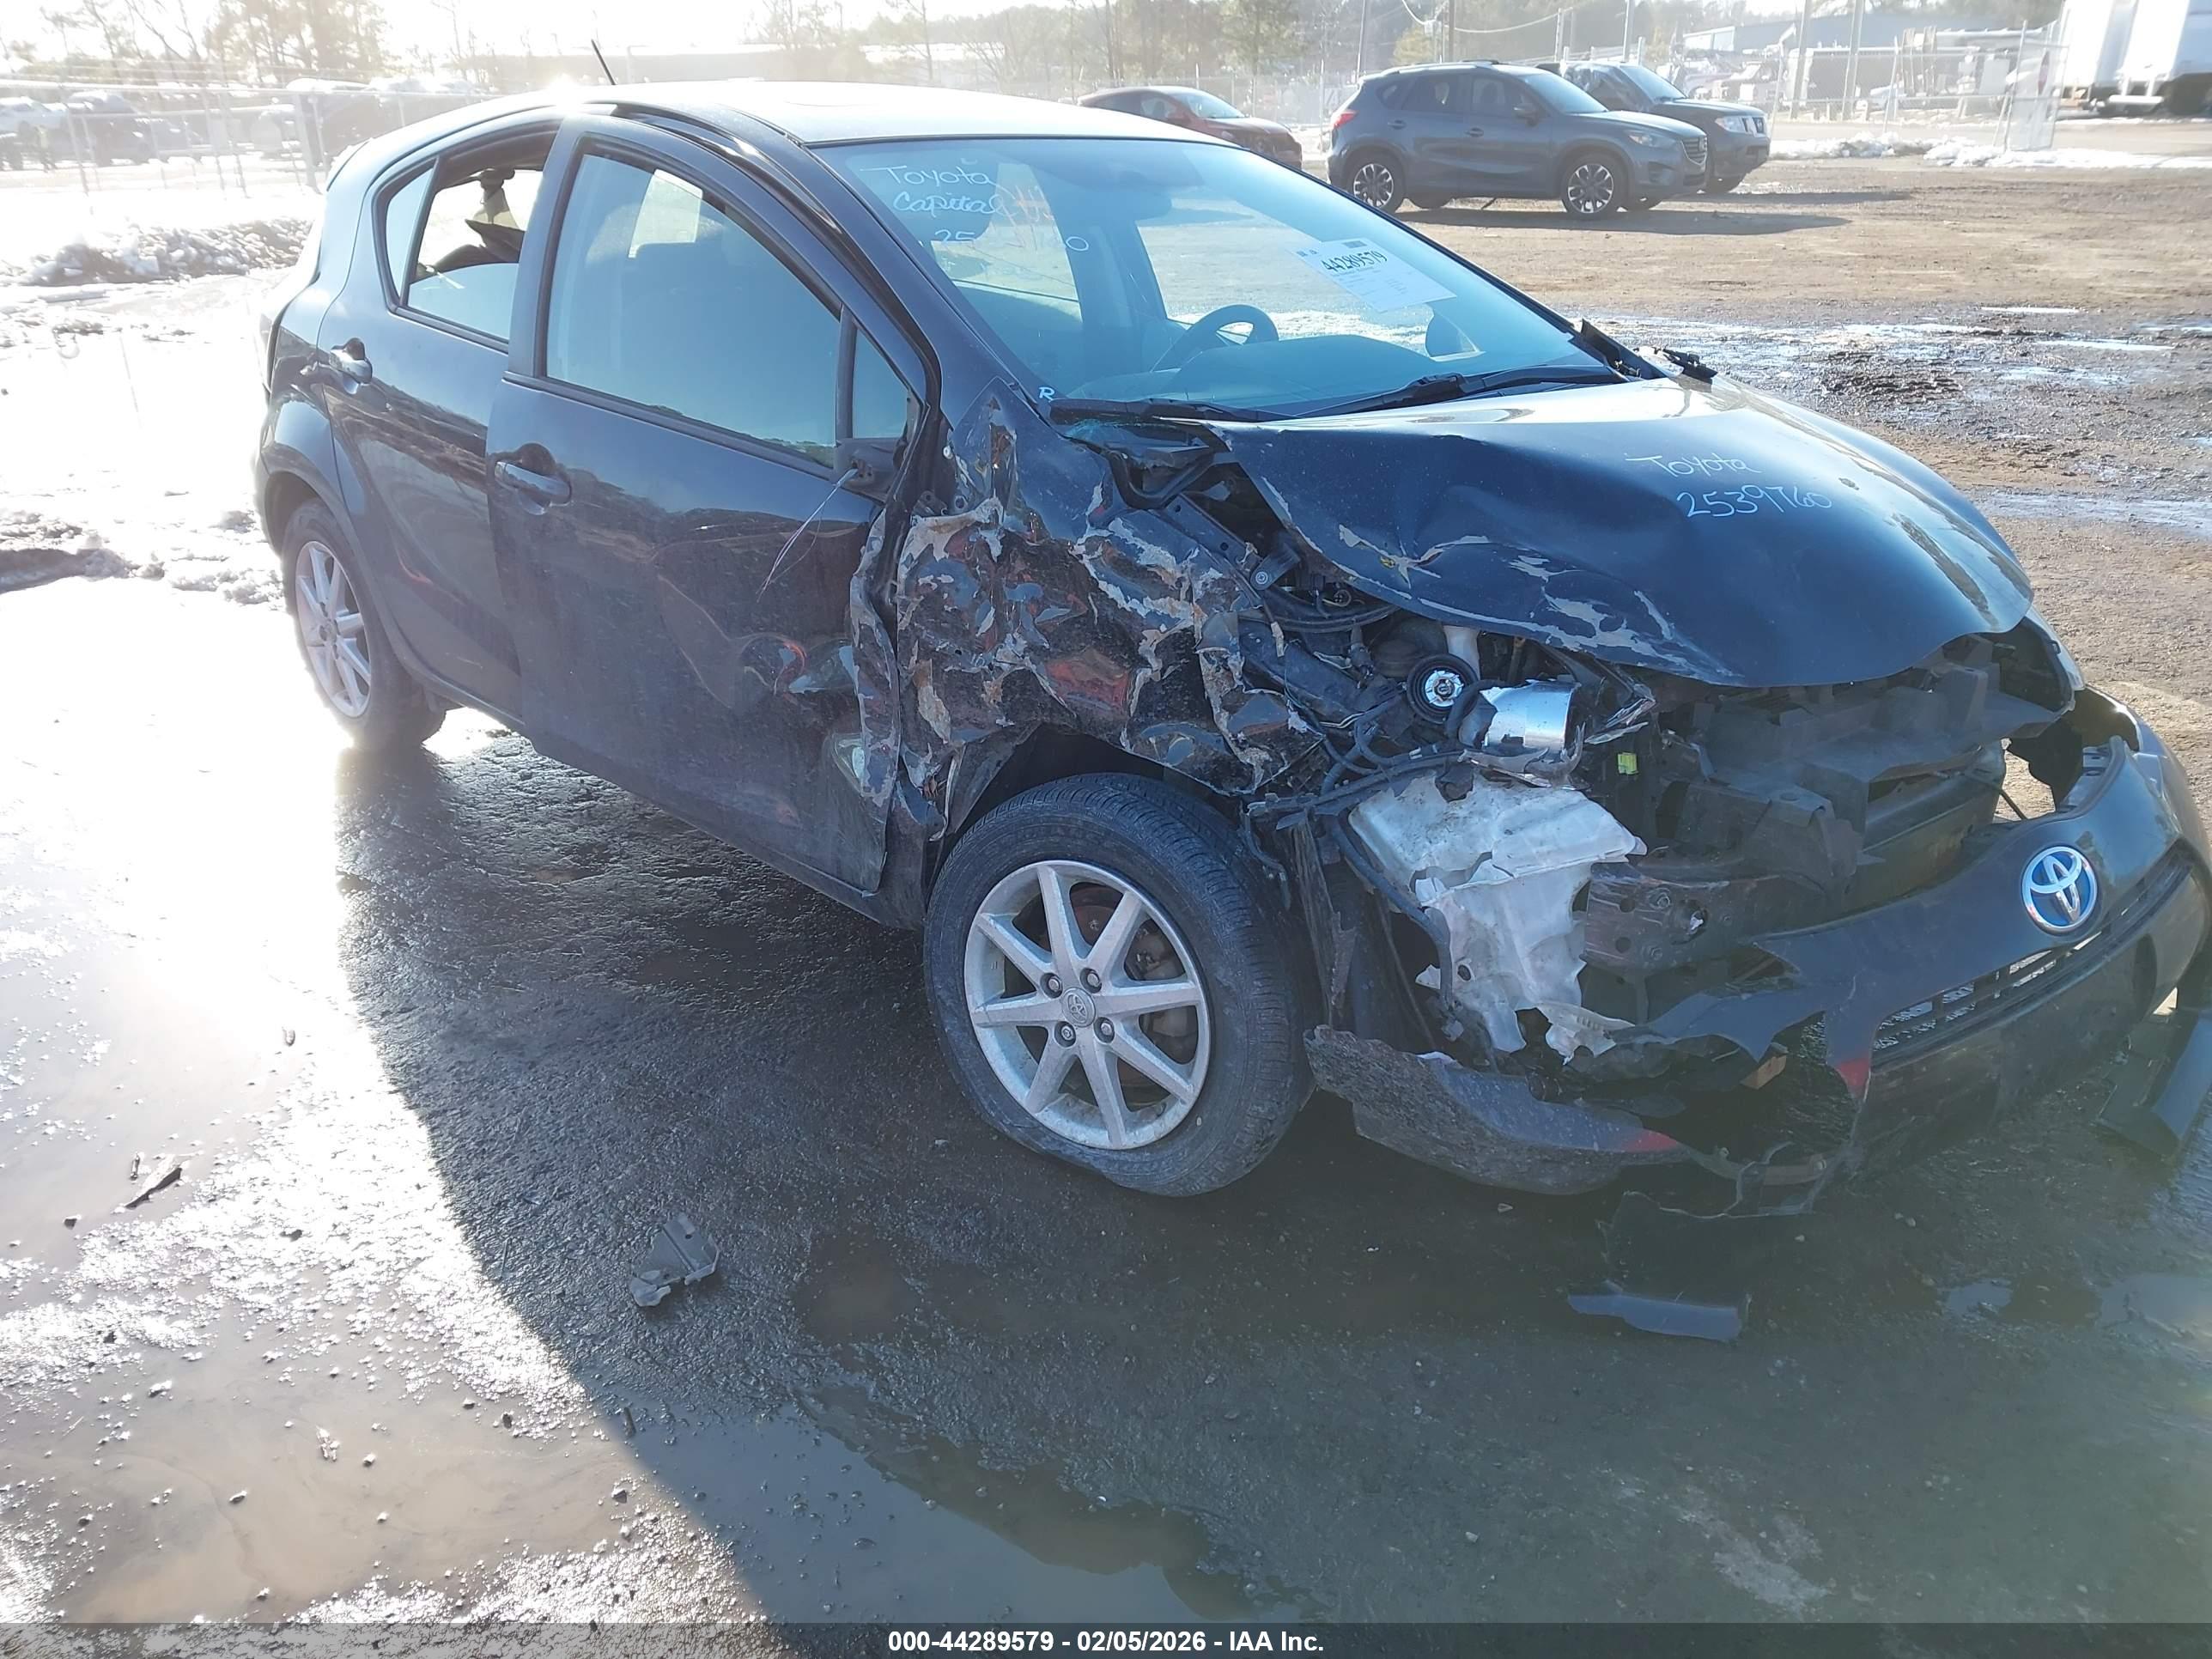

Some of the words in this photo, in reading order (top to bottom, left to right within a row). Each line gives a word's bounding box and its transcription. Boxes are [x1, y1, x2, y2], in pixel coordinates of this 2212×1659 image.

[860, 165, 1006, 194] Toyota
[1321, 250, 1388, 272] 44289579
[1039, 386, 1055, 402] R
[1626, 453, 1762, 477] Toyota
[1677, 484, 1832, 517] 2539760
